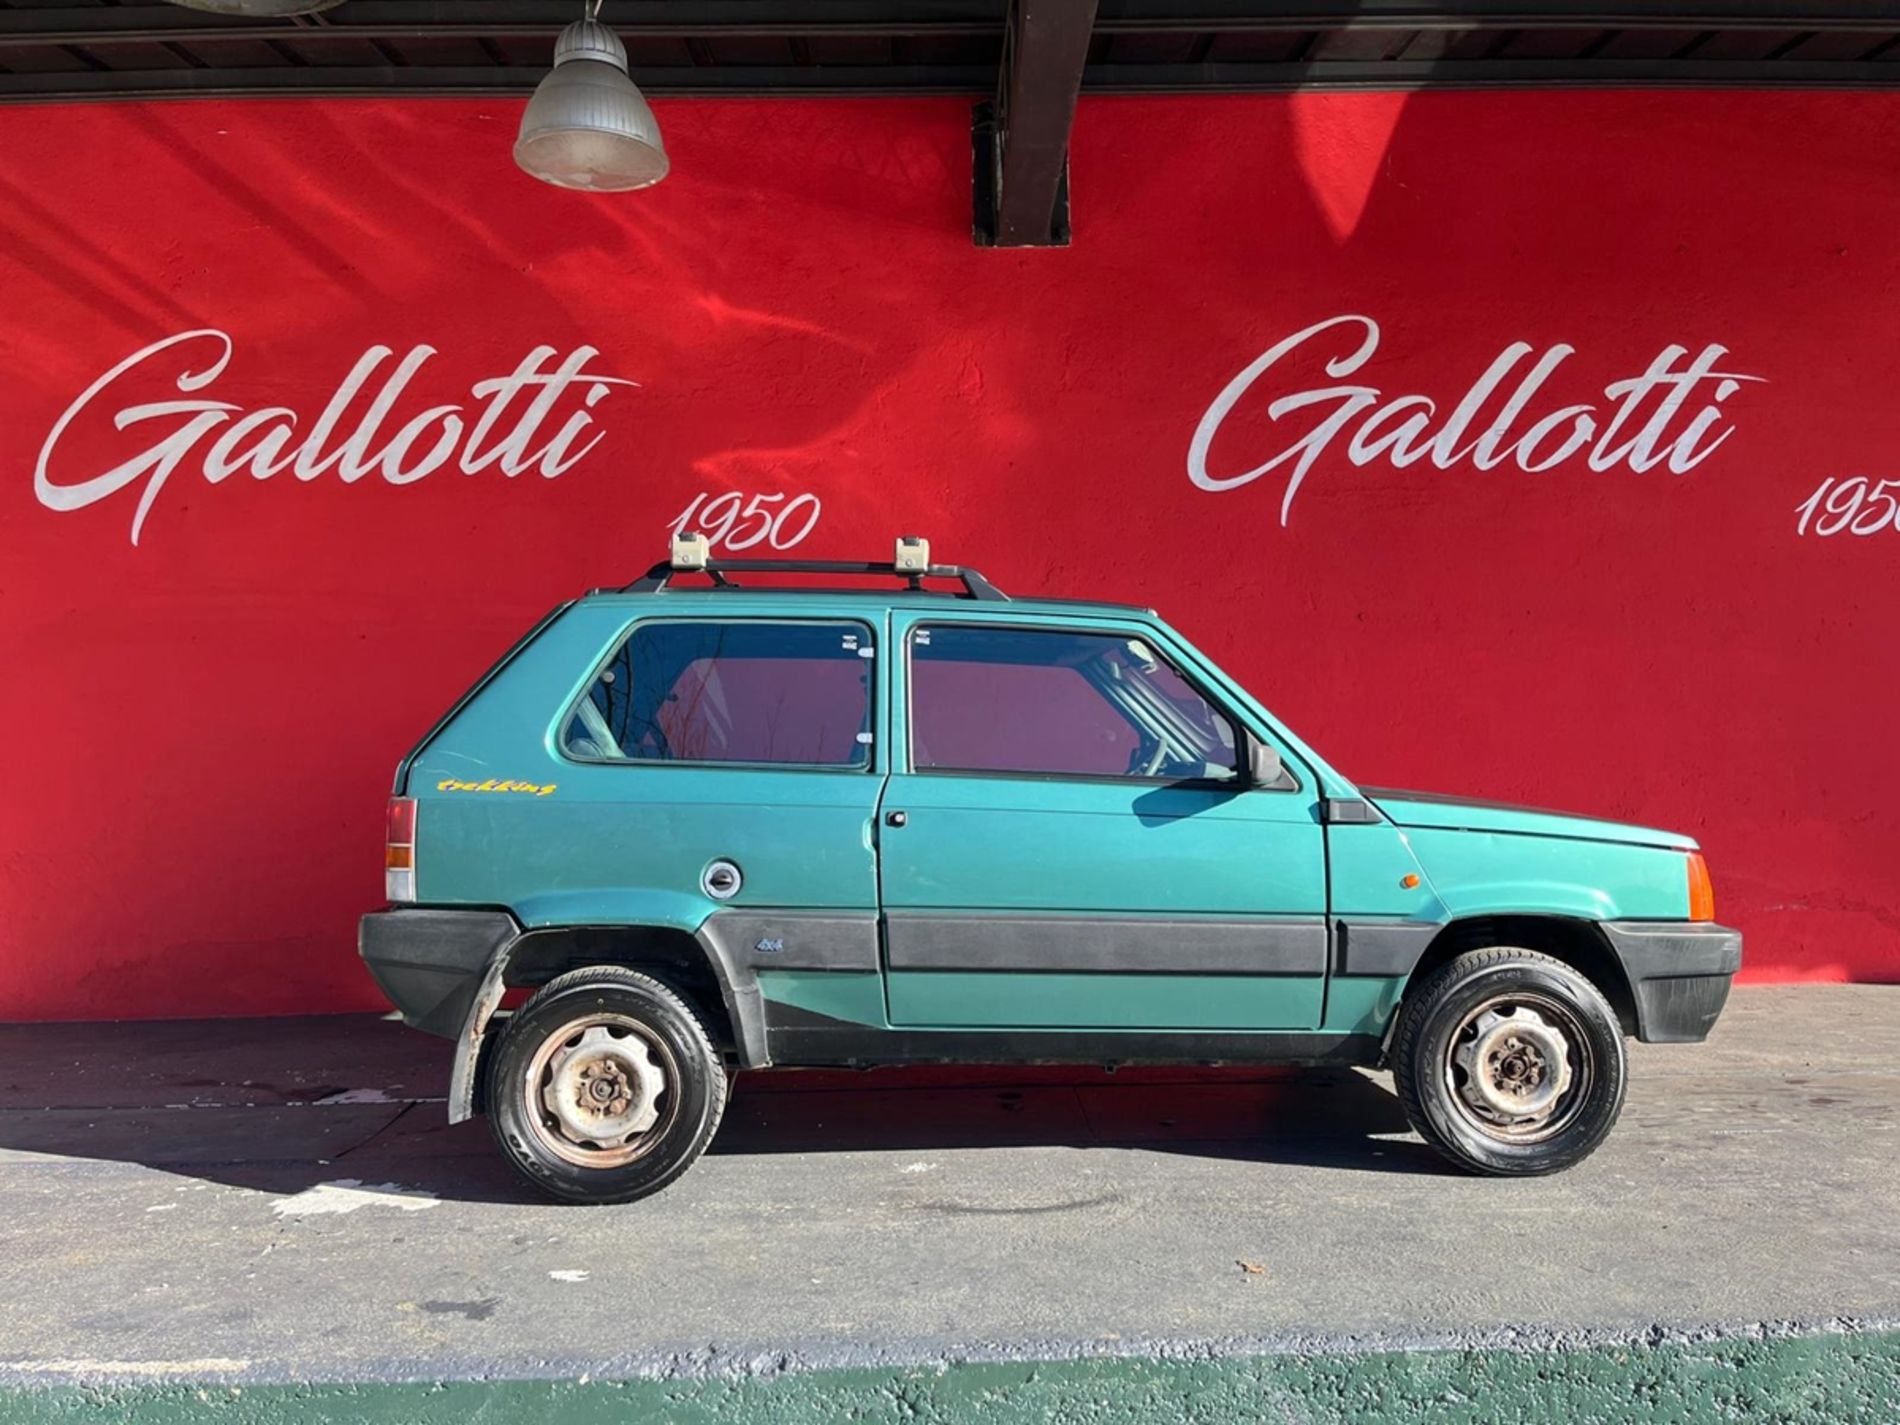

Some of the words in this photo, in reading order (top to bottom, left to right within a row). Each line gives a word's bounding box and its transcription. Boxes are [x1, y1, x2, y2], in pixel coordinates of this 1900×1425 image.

[33, 328, 641, 546] Gallotti
[1186, 314, 1768, 527] Gallotti
[1795, 476, 1900, 536] 195
[437, 778, 557, 796] trekking
